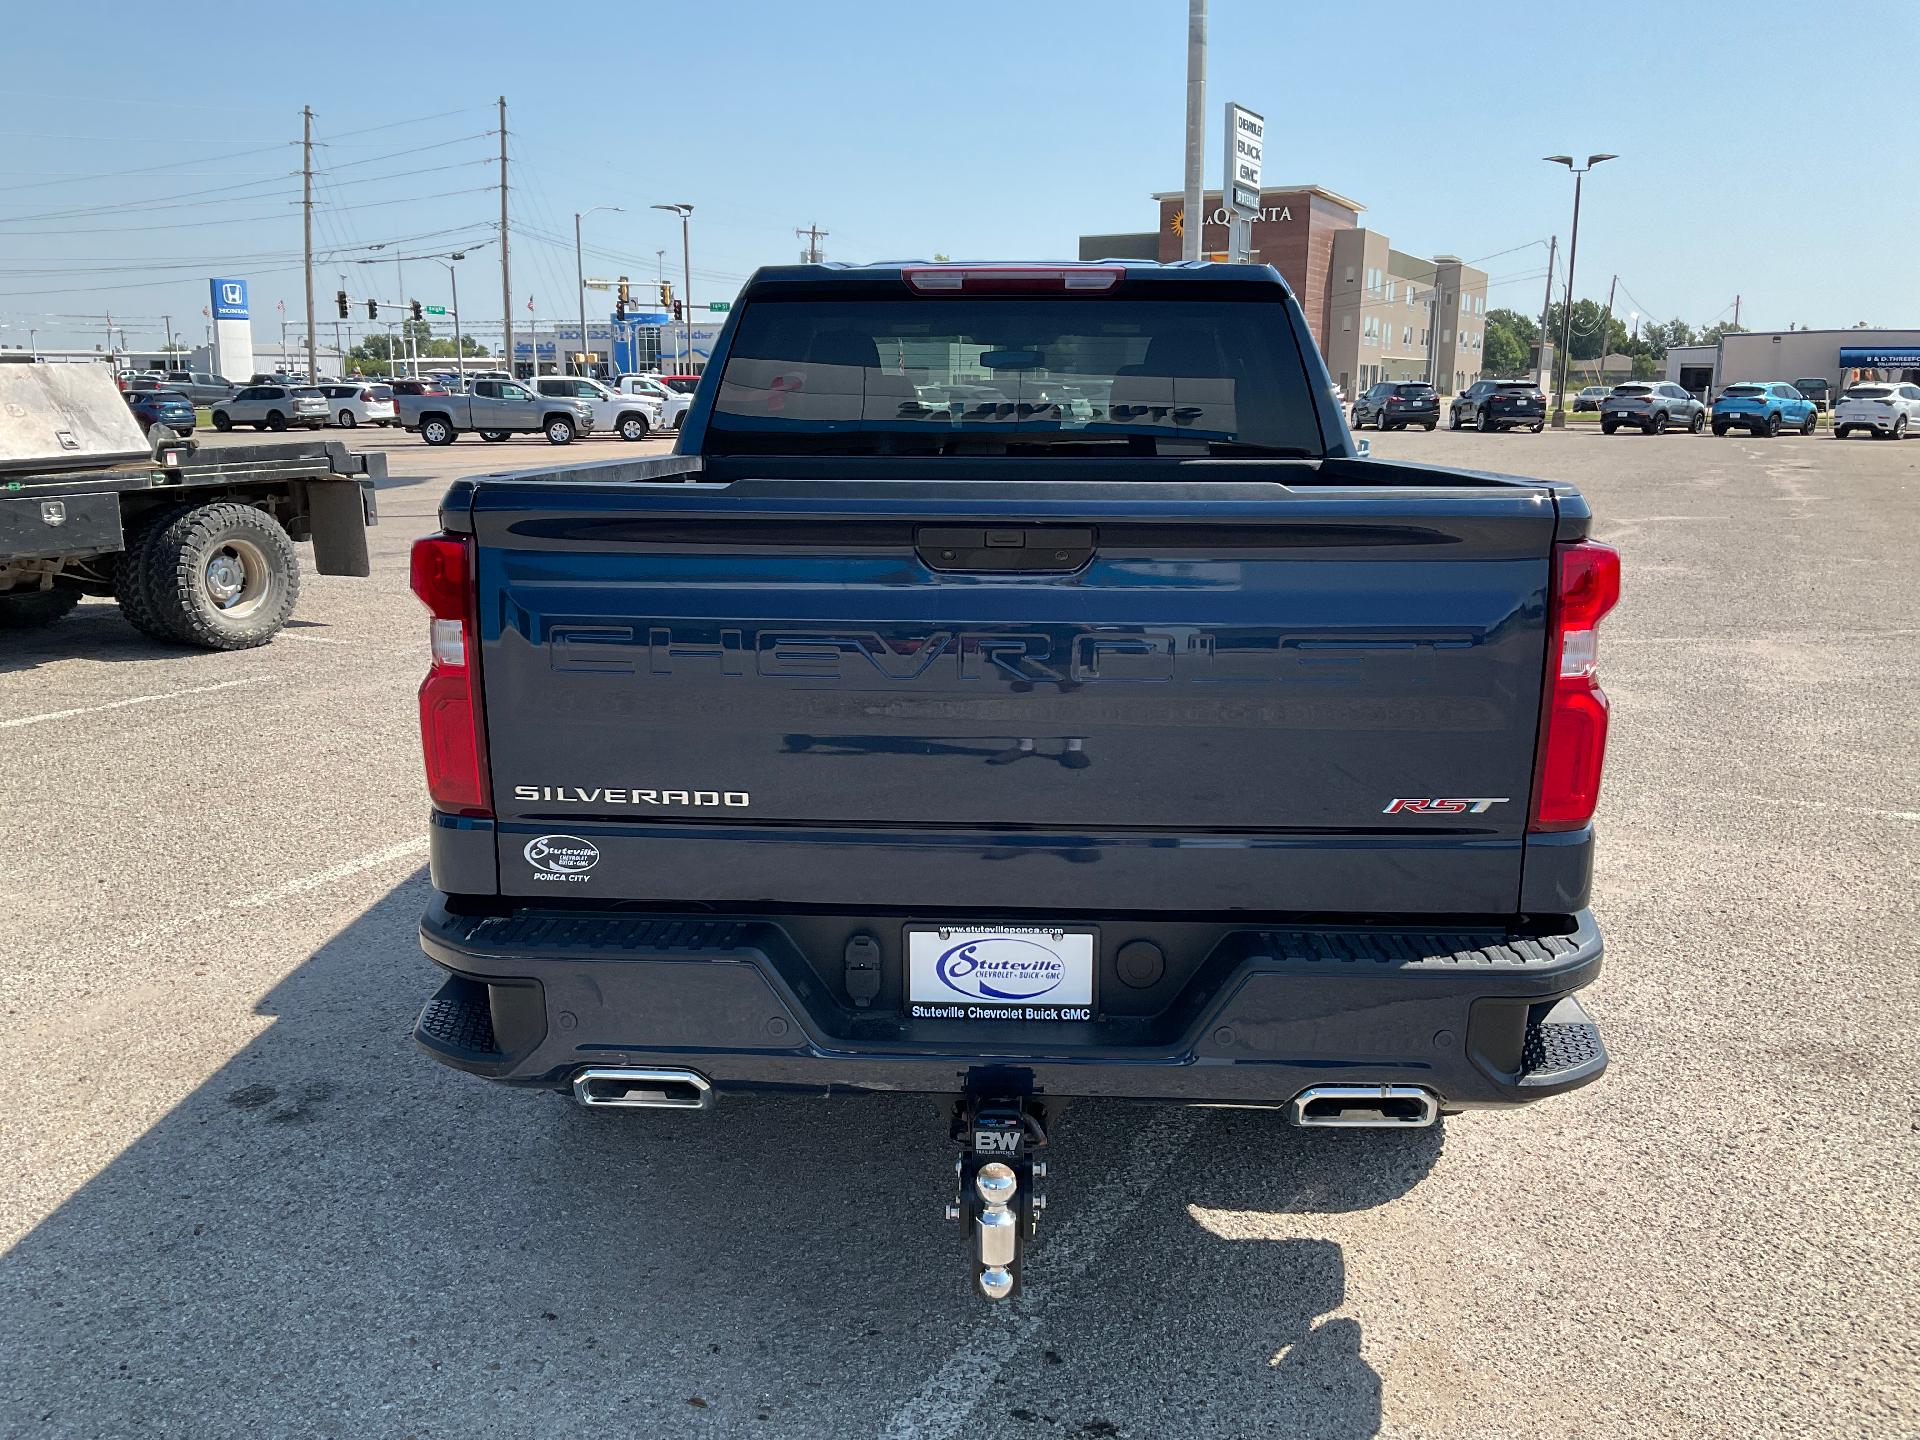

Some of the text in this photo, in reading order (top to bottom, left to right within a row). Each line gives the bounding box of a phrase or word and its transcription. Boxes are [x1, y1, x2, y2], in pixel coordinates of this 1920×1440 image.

[1238, 116, 1263, 138] CHEVROLET
[1237, 139, 1261, 162] BUICK
[1240, 164, 1258, 184] GMC
[550, 625, 1474, 684] CHEVROLET
[514, 785, 750, 807] SILVERADO
[1382, 798, 1510, 813] RST
[531, 839, 597, 858] Stuteville
[534, 872, 590, 882] PONCA CITY
[939, 926, 1063, 934] www.stutevilleponca.com
[949, 945, 1061, 978] Stuteville
[975, 970, 1013, 979] CHEVROLET
[1045, 972, 1060, 980] GMC
[912, 1006, 1090, 1020] Stuteville Chevrolet Buick GMC
